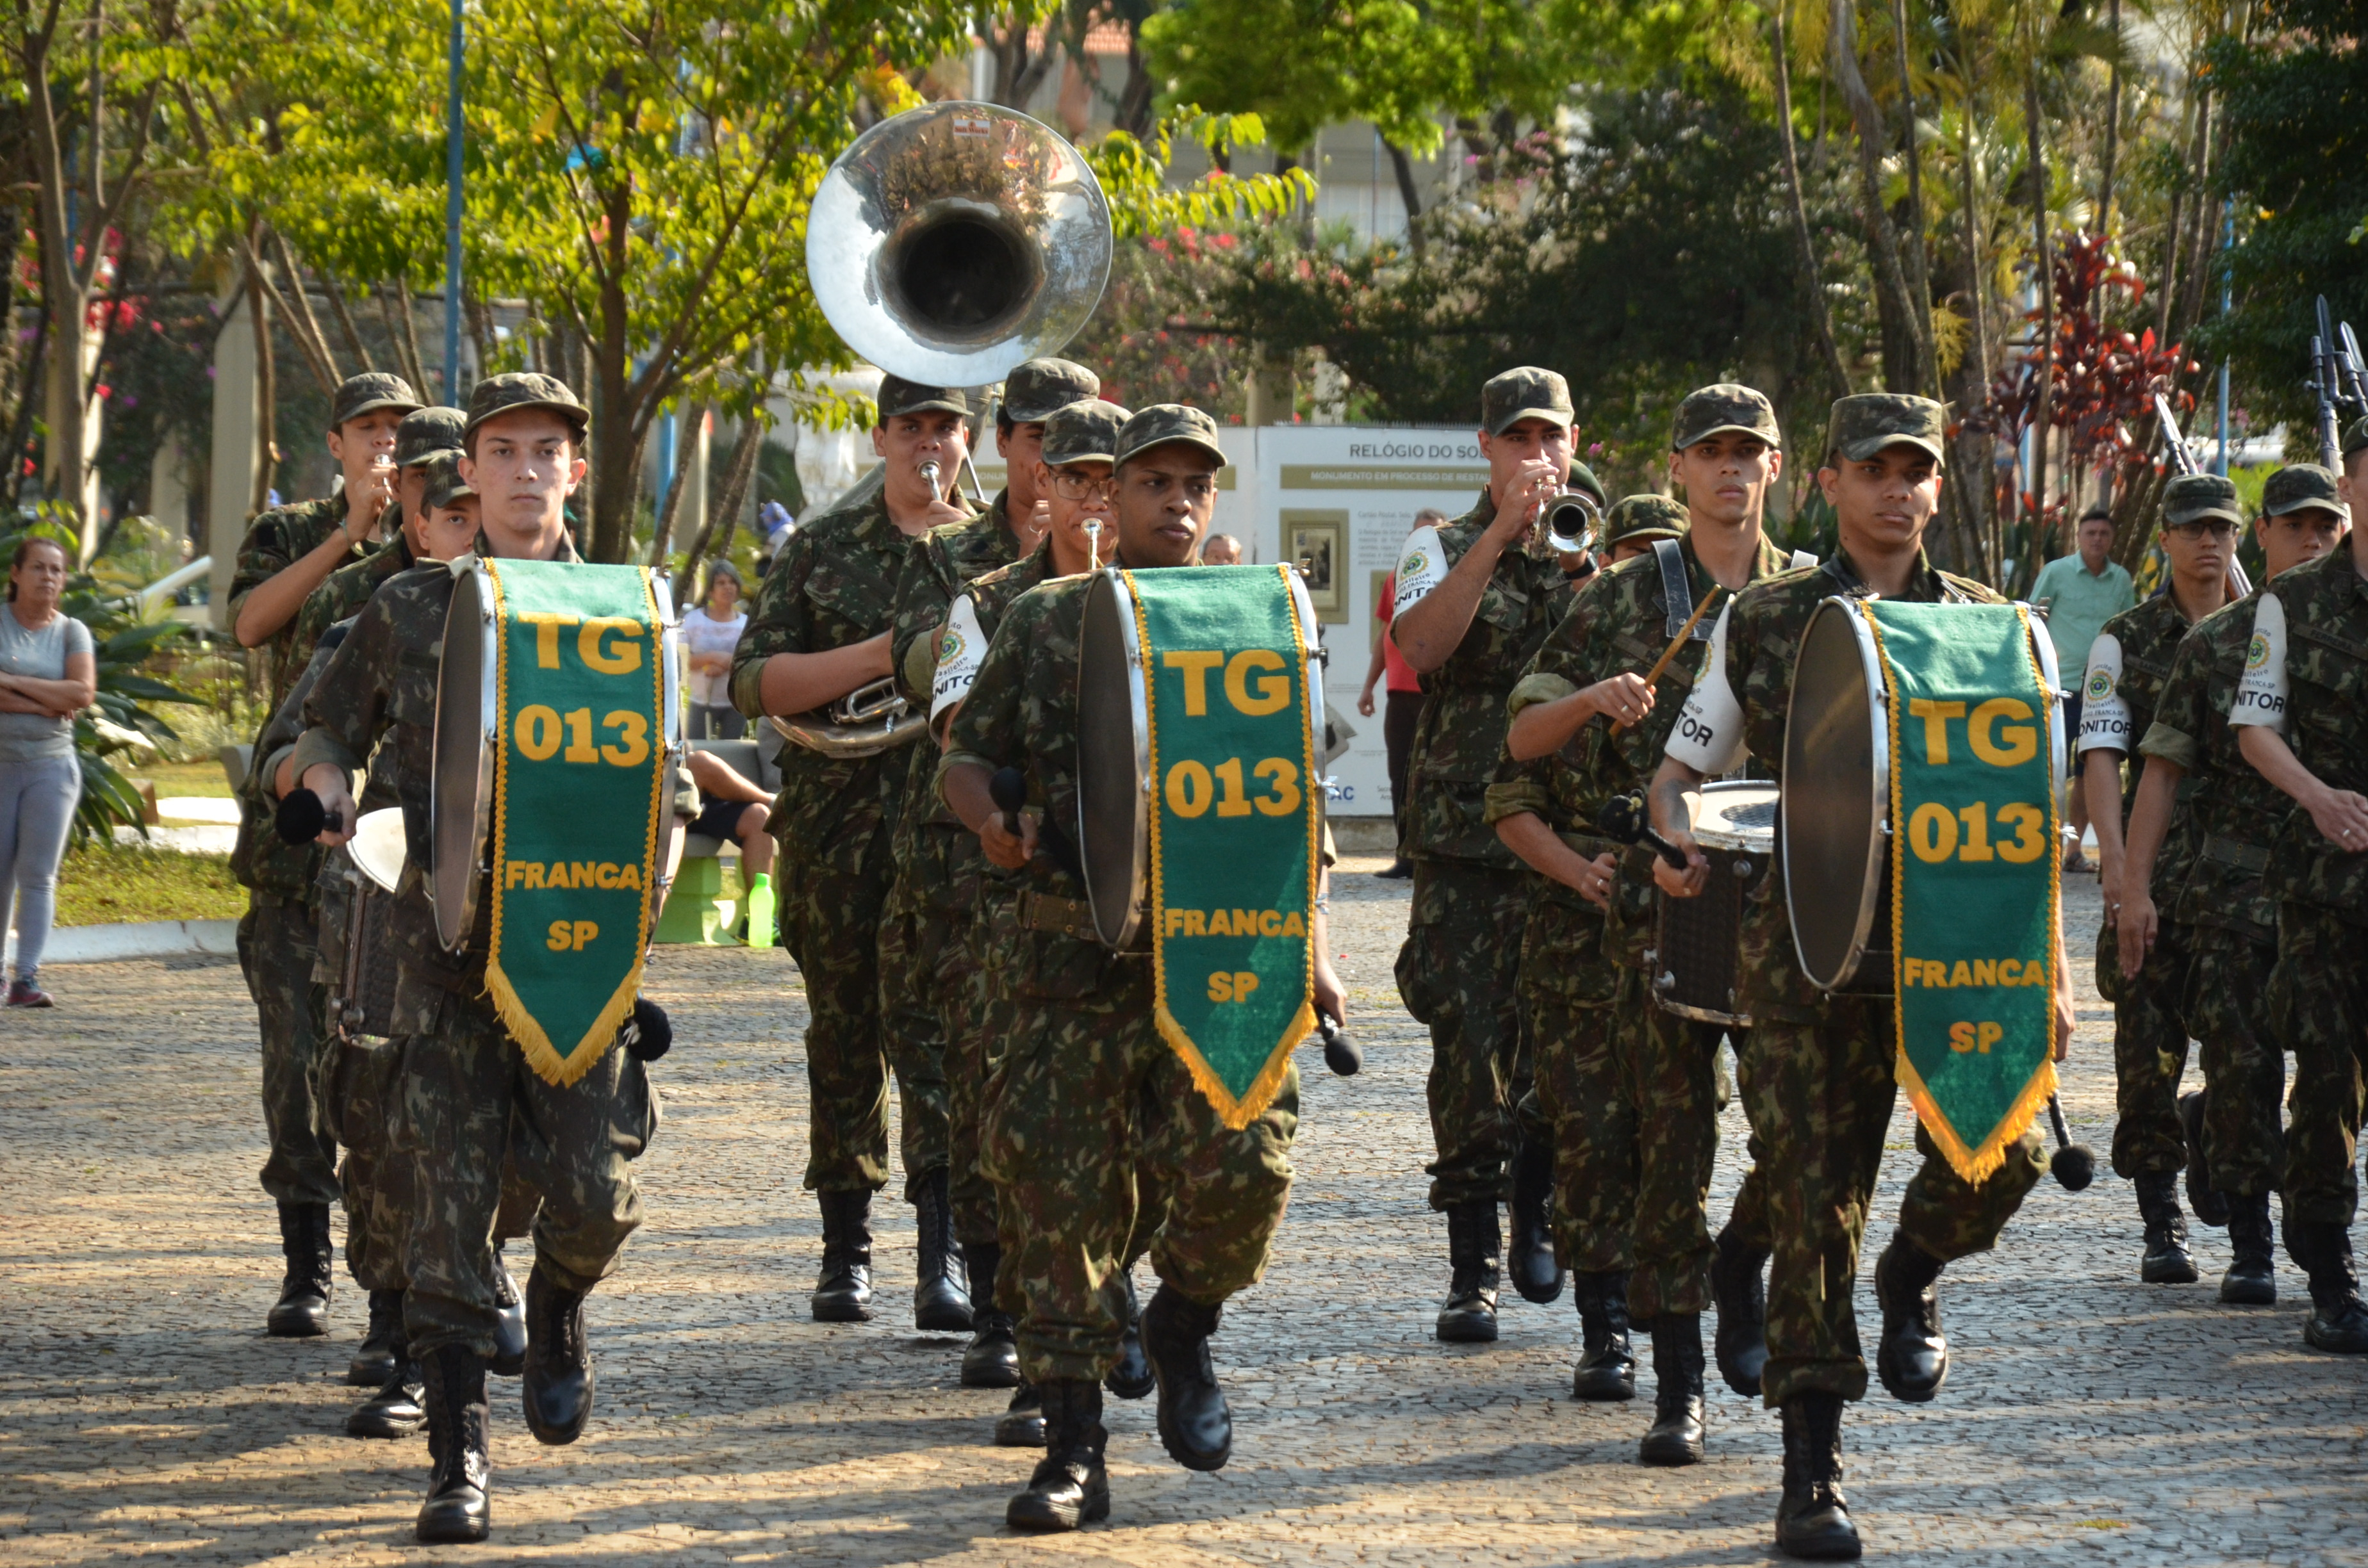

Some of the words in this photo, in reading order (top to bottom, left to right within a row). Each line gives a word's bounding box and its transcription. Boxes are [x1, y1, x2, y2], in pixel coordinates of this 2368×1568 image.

[1349, 441, 1424, 457] RELÓGIO
[1428, 445, 1452, 458] DO
[1311, 471, 1372, 480] MONUMENTO
[1374, 471, 1388, 480] EM
[1390, 471, 1440, 480] PROCESSO
[518, 611, 643, 675] TG
[1163, 649, 1290, 716] TG
[514, 705, 650, 767] 013
[1909, 698, 2037, 767] TG
[1165, 757, 1301, 819] 013
[1328, 785, 1354, 801] AC
[1908, 802, 2046, 863] 013
[506, 860, 643, 890] FRANCA
[547, 920, 599, 951] SP
[1165, 908, 1306, 938] FRANCA
[1208, 972, 1259, 1002] SP
[1903, 957, 2046, 988] FRANCA
[1950, 1022, 2003, 1054] SP
